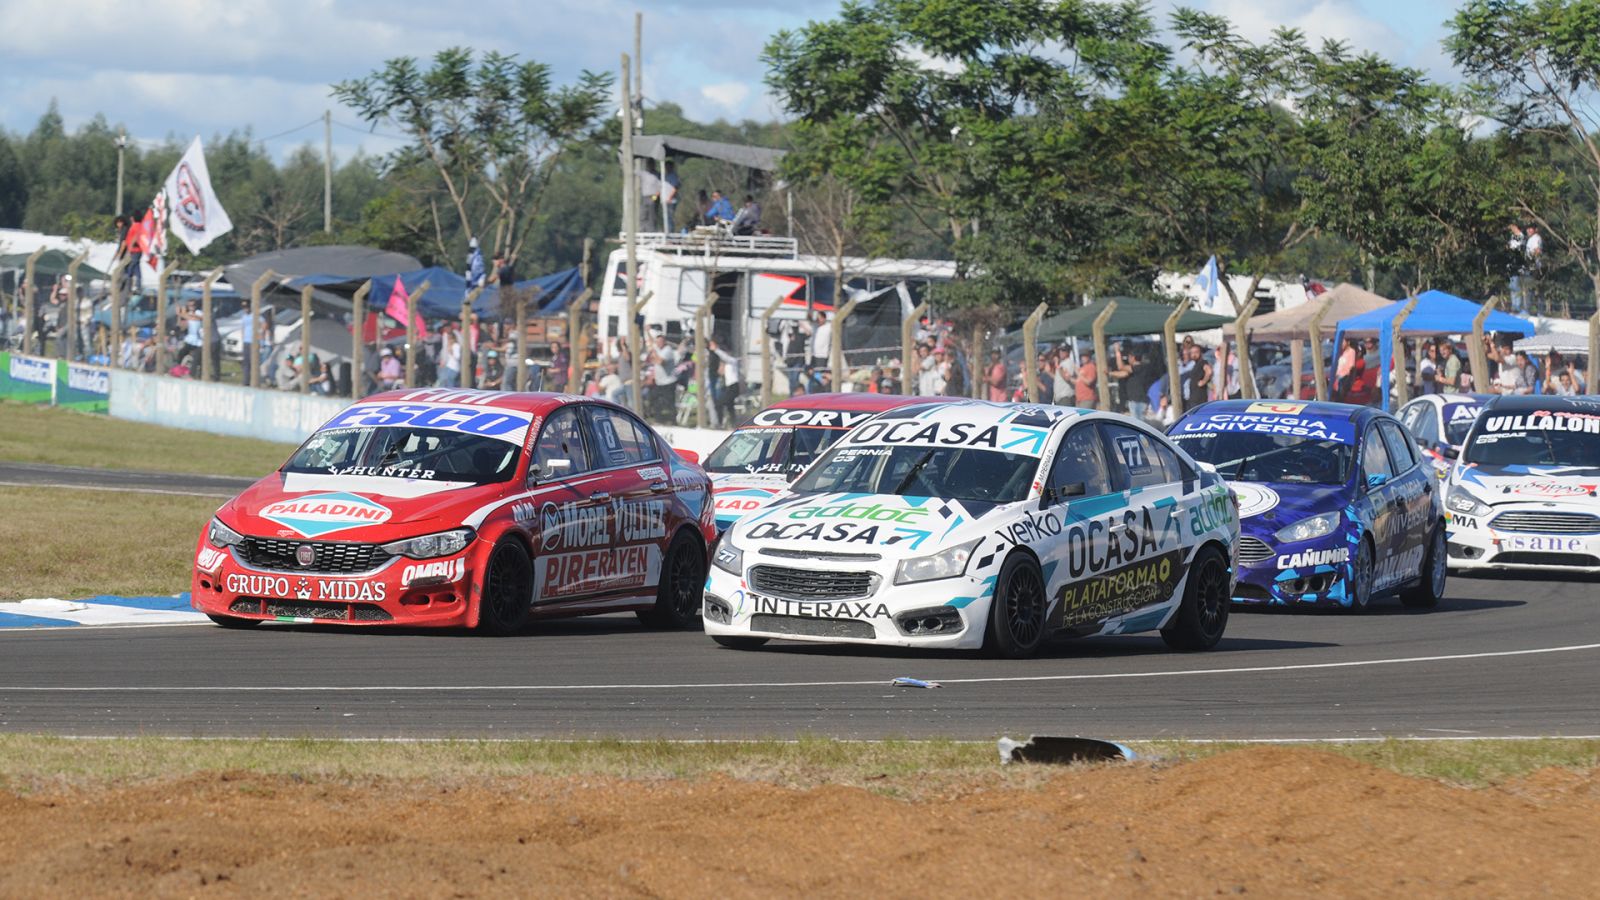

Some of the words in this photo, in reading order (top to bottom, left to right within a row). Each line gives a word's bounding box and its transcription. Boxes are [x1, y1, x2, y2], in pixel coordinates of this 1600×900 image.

[753, 409, 878, 428] CORV
[1210, 414, 1327, 429] CIRUGIA
[603, 421, 616, 448] 8
[850, 422, 999, 448] OCASA
[1184, 422, 1344, 442] UNIVERSAL
[837, 449, 892, 458] PERNIA
[1121, 440, 1144, 467] 77
[352, 465, 435, 480] HUNTER
[267, 503, 388, 521] PALADINI
[788, 503, 929, 525] addoc
[563, 501, 610, 548] MOREL
[746, 522, 879, 546] OCASA
[995, 511, 1062, 547] verko
[1068, 505, 1158, 579] OCASA
[718, 550, 737, 564] 77
[227, 573, 289, 596] GRUPO
[318, 580, 386, 601] MIDAS
[1063, 566, 1157, 612] PLATAFORMA
[750, 595, 893, 619] INTERAXA
